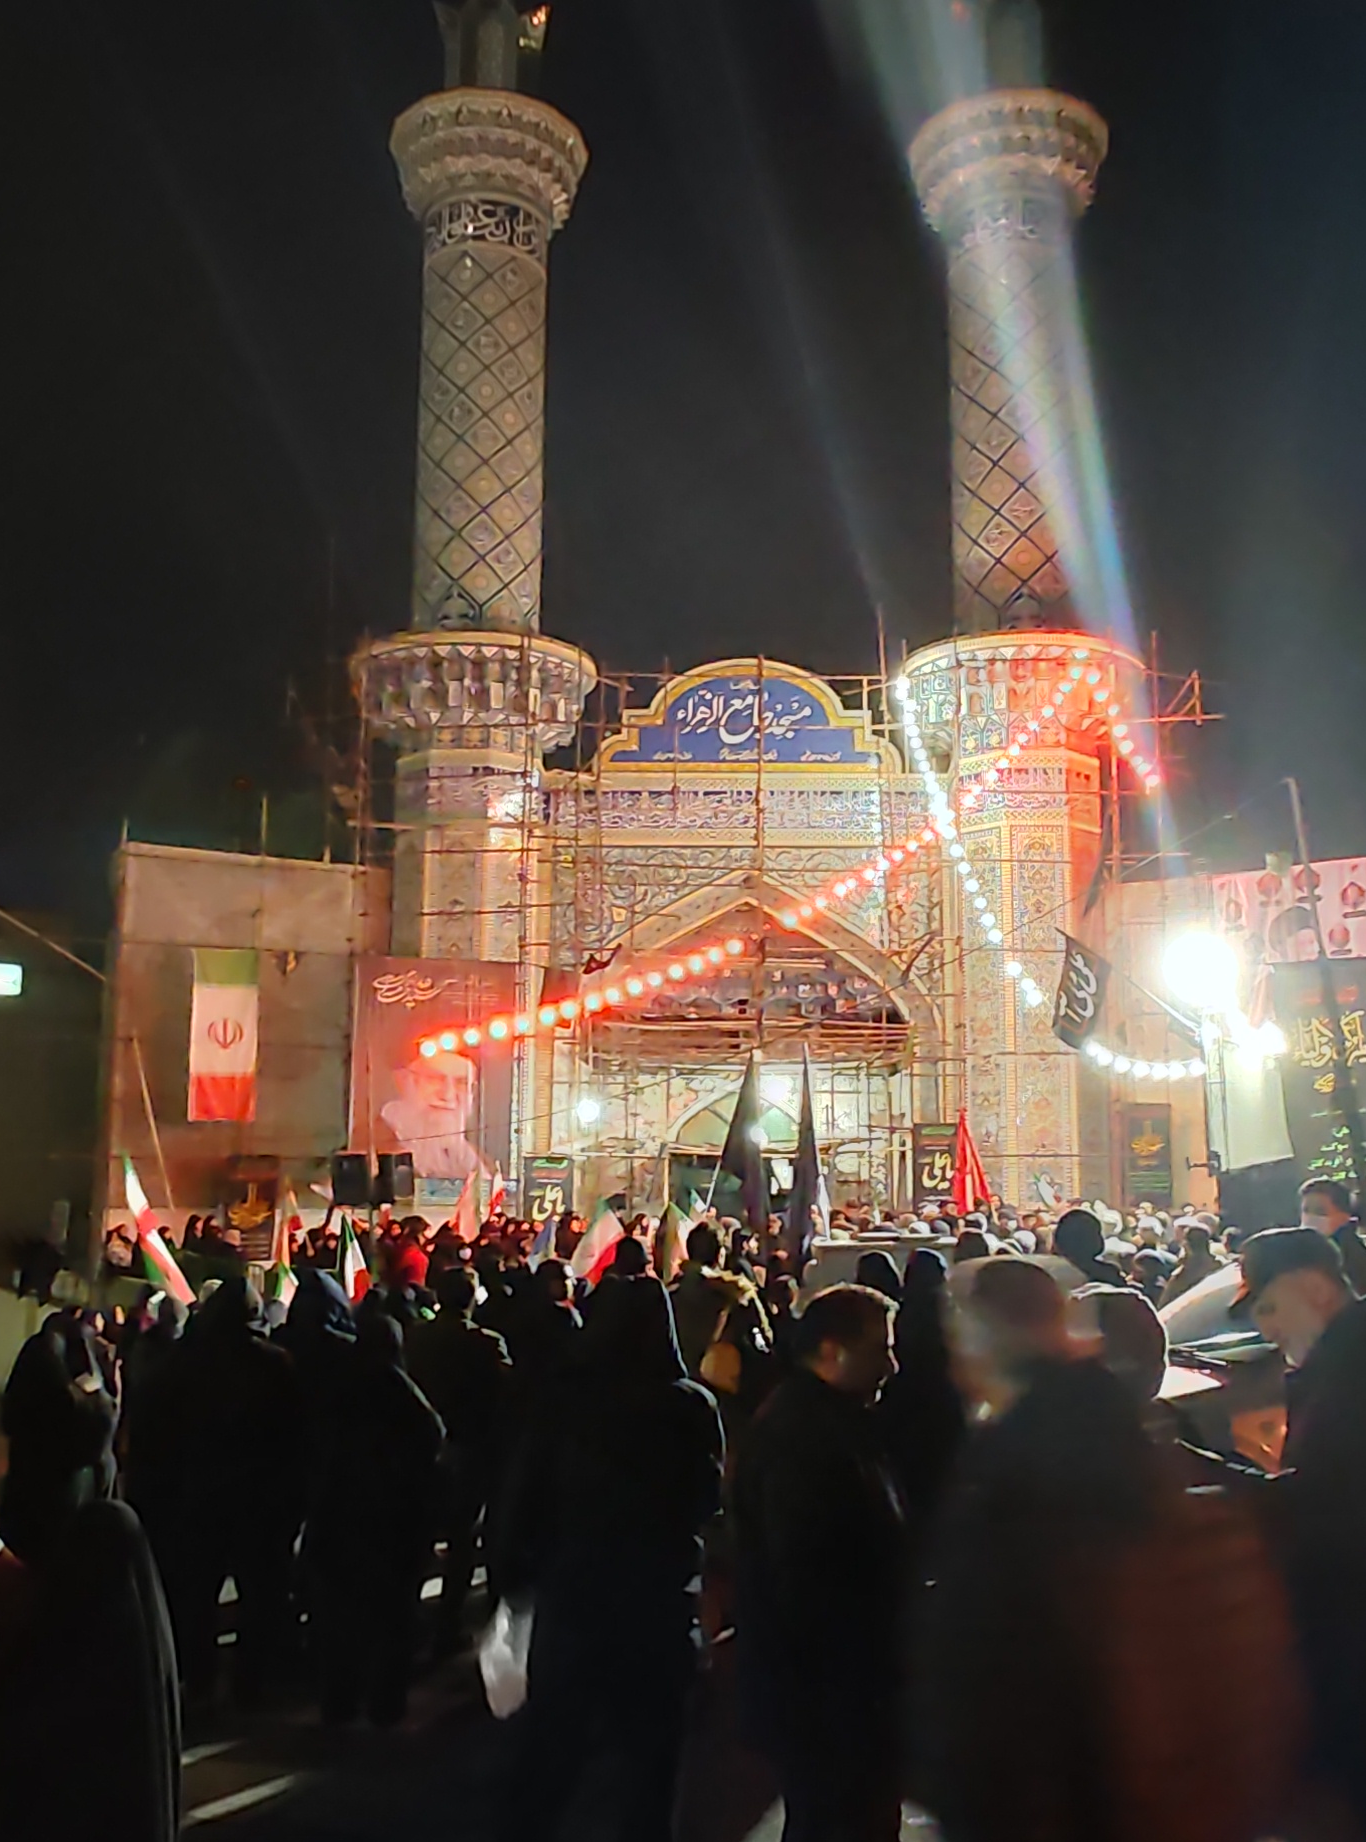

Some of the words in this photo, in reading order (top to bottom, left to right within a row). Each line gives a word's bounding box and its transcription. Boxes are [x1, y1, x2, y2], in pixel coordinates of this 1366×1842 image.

[676, 689, 725, 734] الزهراء
[718, 694, 774, 745] جامع
[763, 695, 812, 740] مسجد
